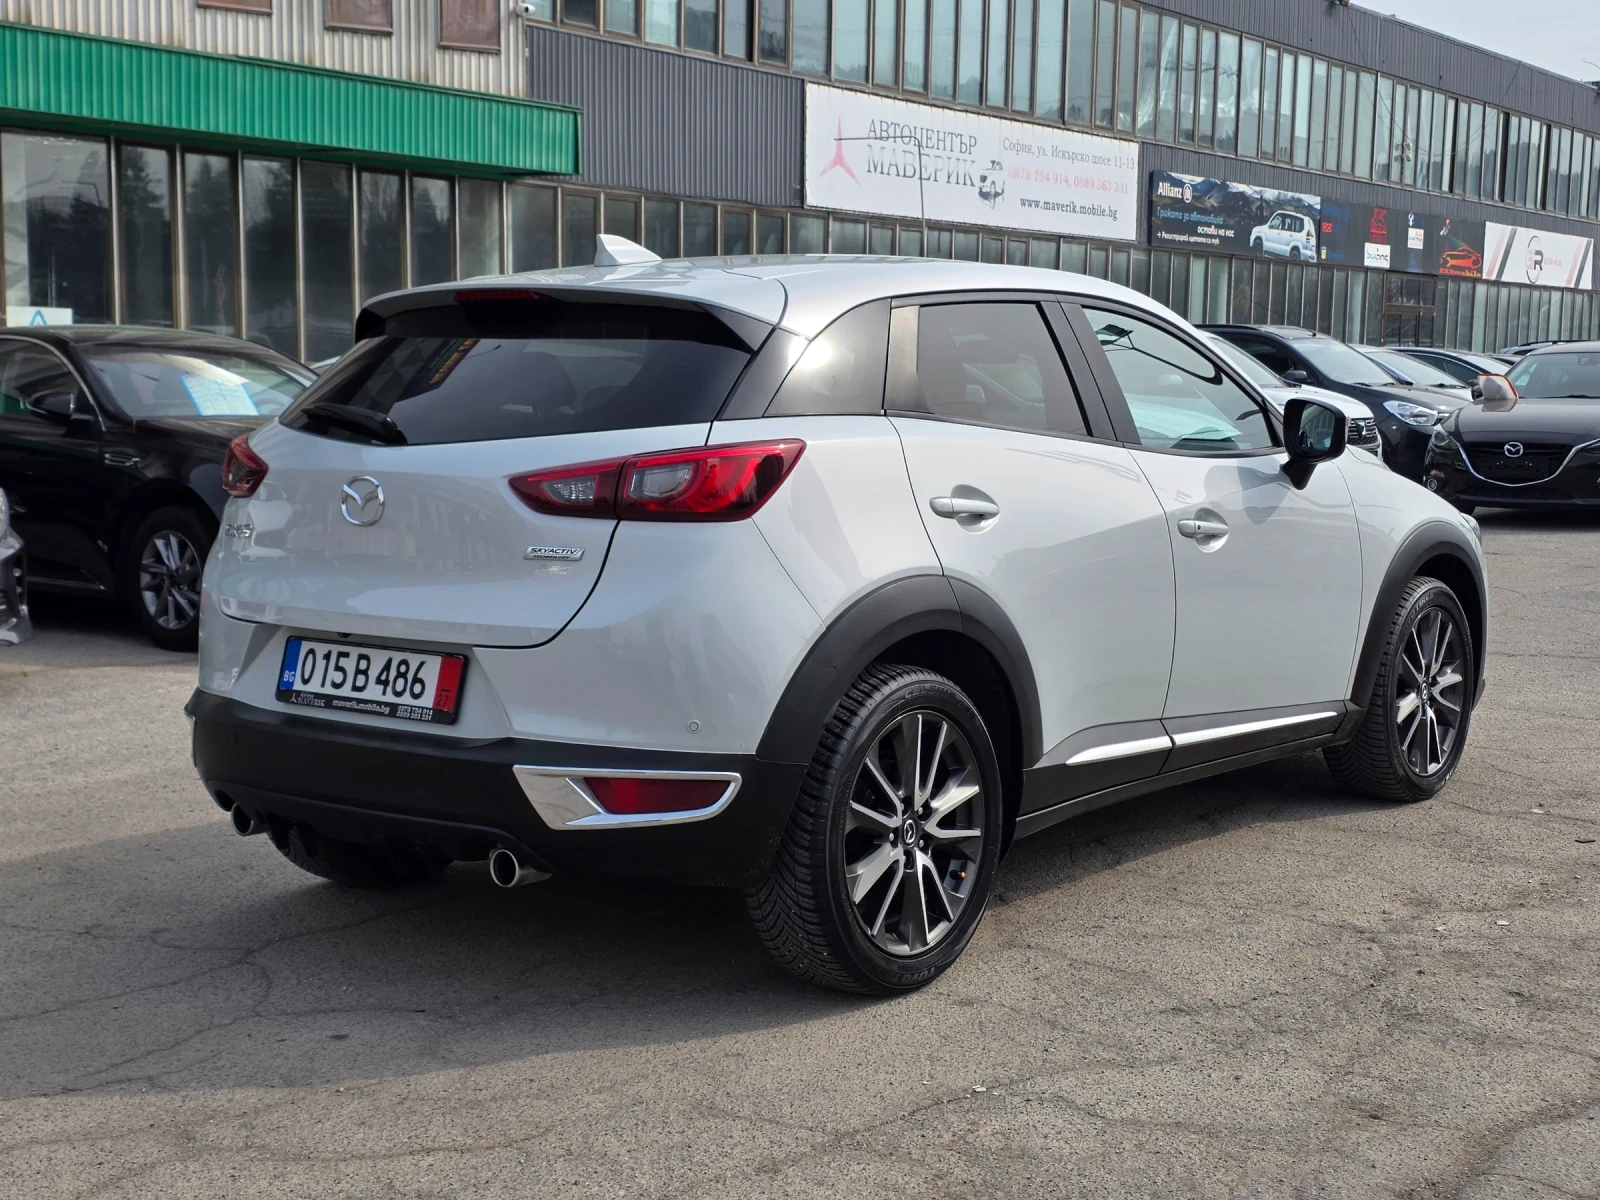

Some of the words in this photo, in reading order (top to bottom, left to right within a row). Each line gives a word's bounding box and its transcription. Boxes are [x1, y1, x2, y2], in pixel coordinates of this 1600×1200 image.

[868, 119, 977, 155] АВТОЦЕНТЪР
[866, 144, 976, 187] МАВЕРИК
[1003, 137, 1034, 156] София,
[1037, 145, 1048, 158] ул.
[1051, 145, 1090, 164] Искърско
[1092, 155, 1112, 166] шосе
[1114, 156, 1135, 170] 11-13
[1034, 170, 1050, 183] 754
[1114, 181, 1128, 195] 331
[1158, 181, 1183, 198] Allianz
[1020, 198, 1118, 221] www.maverik.mobile.bg
[530, 547, 578, 555] SKYACTIV
[283, 670, 295, 682] BG
[301, 648, 427, 700] 015B486
[332, 700, 390, 714] maverik.mobile.bg
